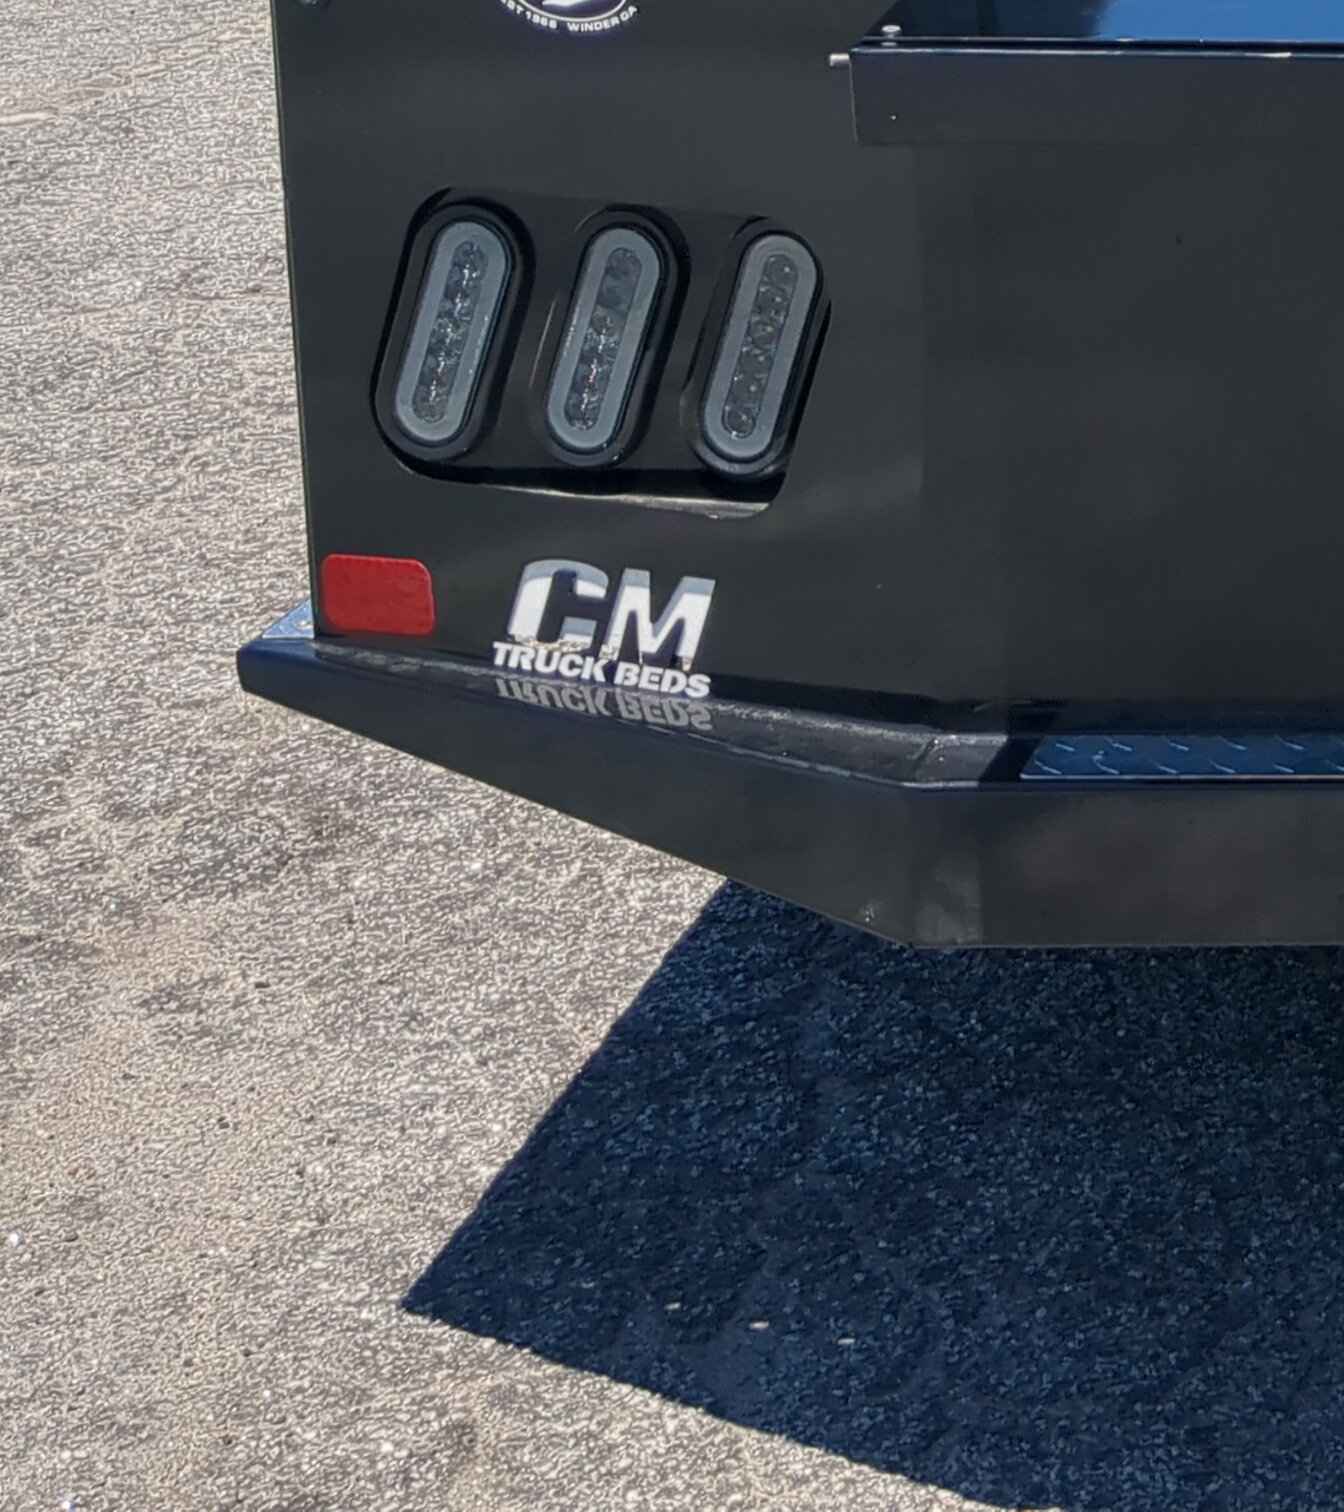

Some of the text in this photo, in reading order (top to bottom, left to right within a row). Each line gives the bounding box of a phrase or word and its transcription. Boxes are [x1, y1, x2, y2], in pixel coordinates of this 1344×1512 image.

[566, 18, 620, 32] WINDER
[620, 5, 638, 21] GA
[505, 558, 716, 672] CM
[493, 641, 712, 698] TRUCK BEDS
